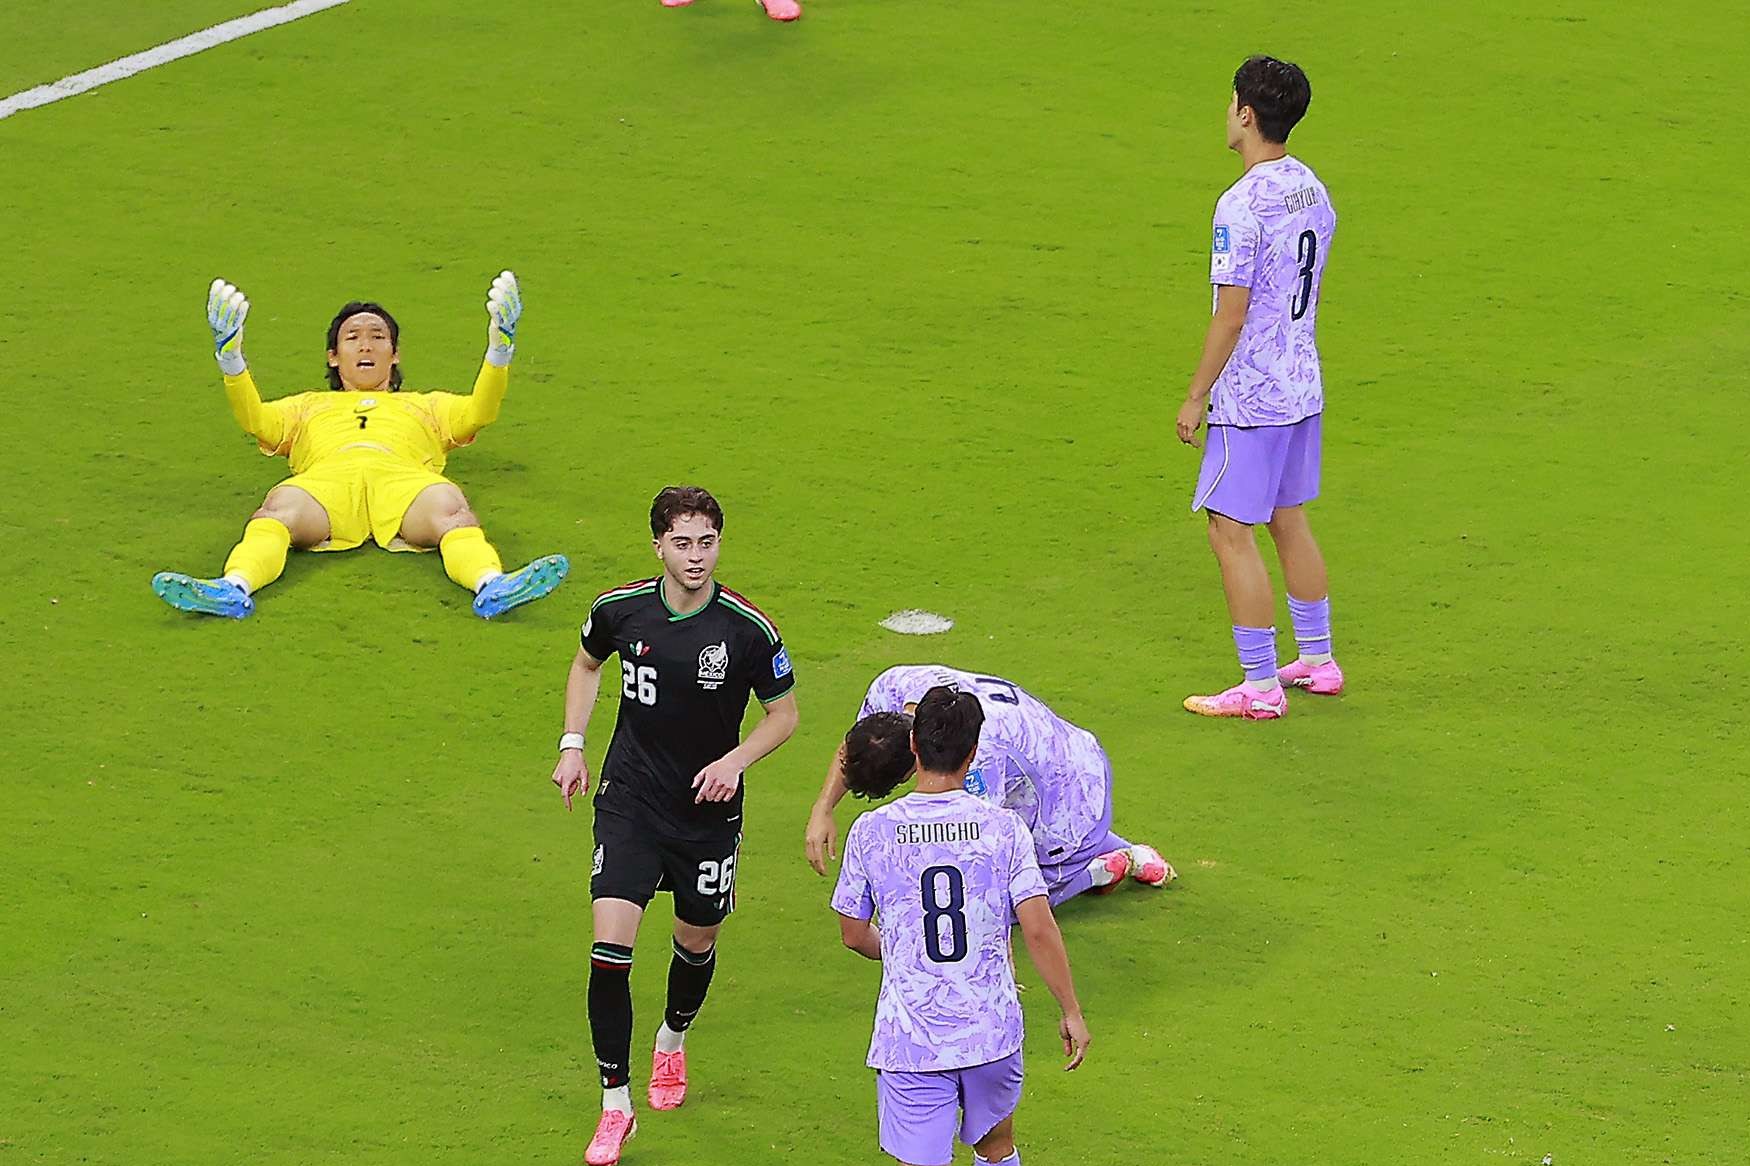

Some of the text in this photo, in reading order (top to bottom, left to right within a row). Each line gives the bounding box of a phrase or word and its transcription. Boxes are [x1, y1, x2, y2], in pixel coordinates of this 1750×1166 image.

[1290, 229, 1317, 322] 3
[622, 660, 657, 706] 26
[896, 821, 980, 844] SEUNGHO
[696, 855, 734, 895] 26
[919, 864, 969, 963] 8
